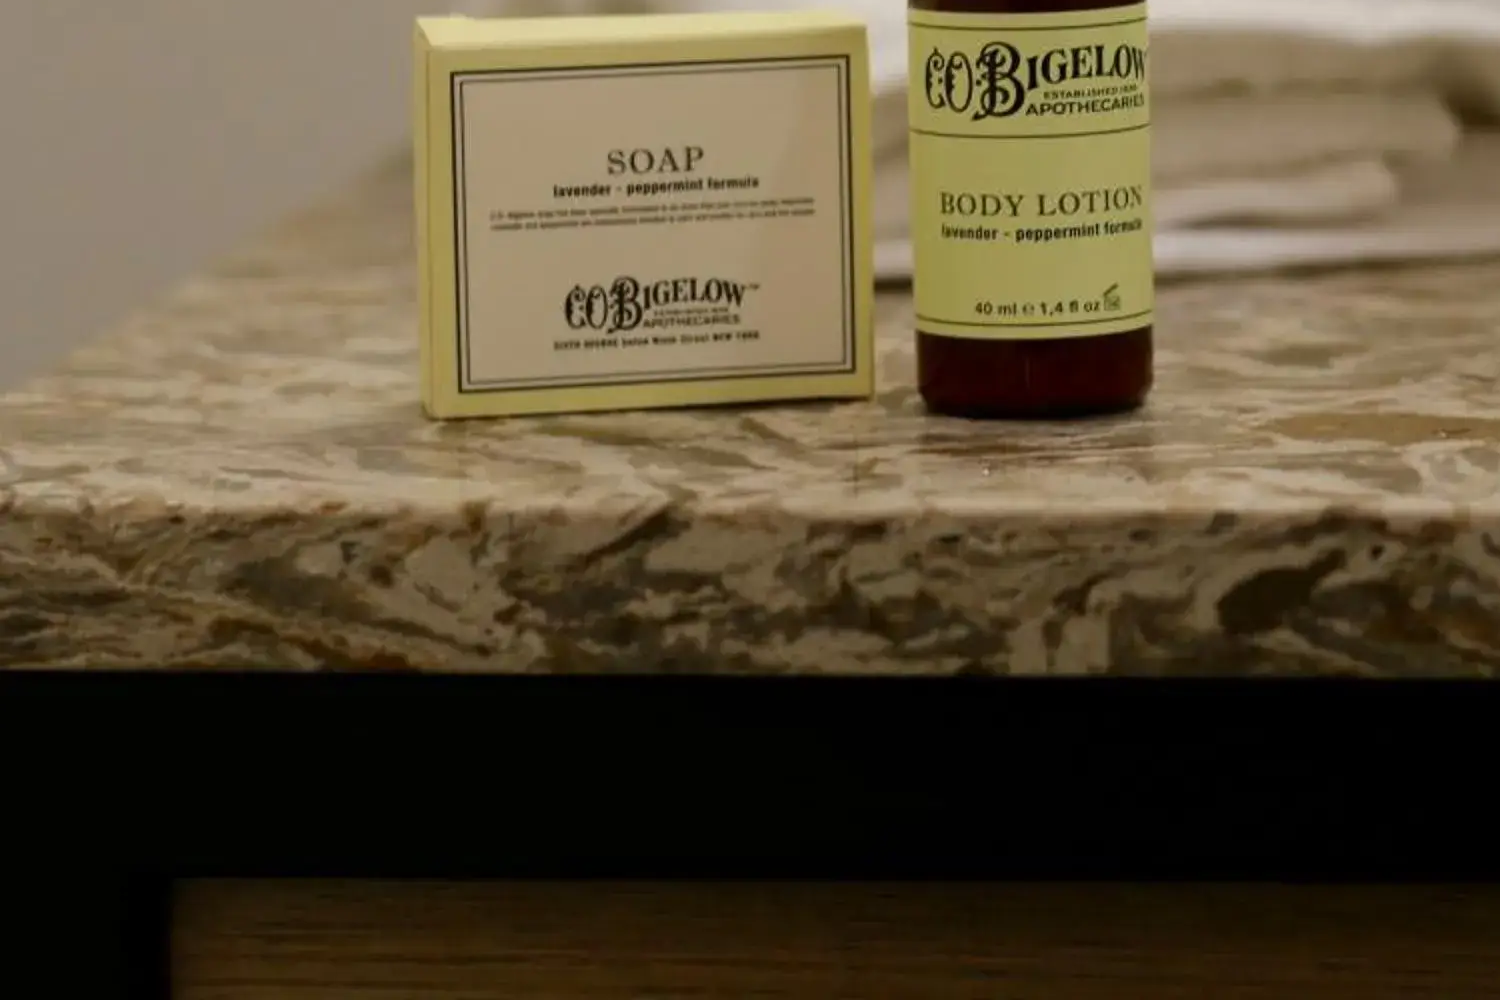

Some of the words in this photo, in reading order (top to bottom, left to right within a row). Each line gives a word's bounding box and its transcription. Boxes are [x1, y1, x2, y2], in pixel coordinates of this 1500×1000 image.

[1025, 92, 1145, 117] APOTHECARIES
[607, 146, 704, 175] SOAP
[553, 183, 611, 198] lavender
[626, 178, 703, 195] peppermint
[707, 176, 759, 190] formula
[939, 190, 1025, 217] BODY
[1037, 185, 1143, 217] LOTION
[941, 223, 999, 240] lavender
[1015, 222, 1099, 243] peppermint
[975, 301, 993, 315] 40
[997, 301, 1017, 316] ml
[1069, 300, 1080, 313] fl
[1083, 302, 1100, 313] oz
